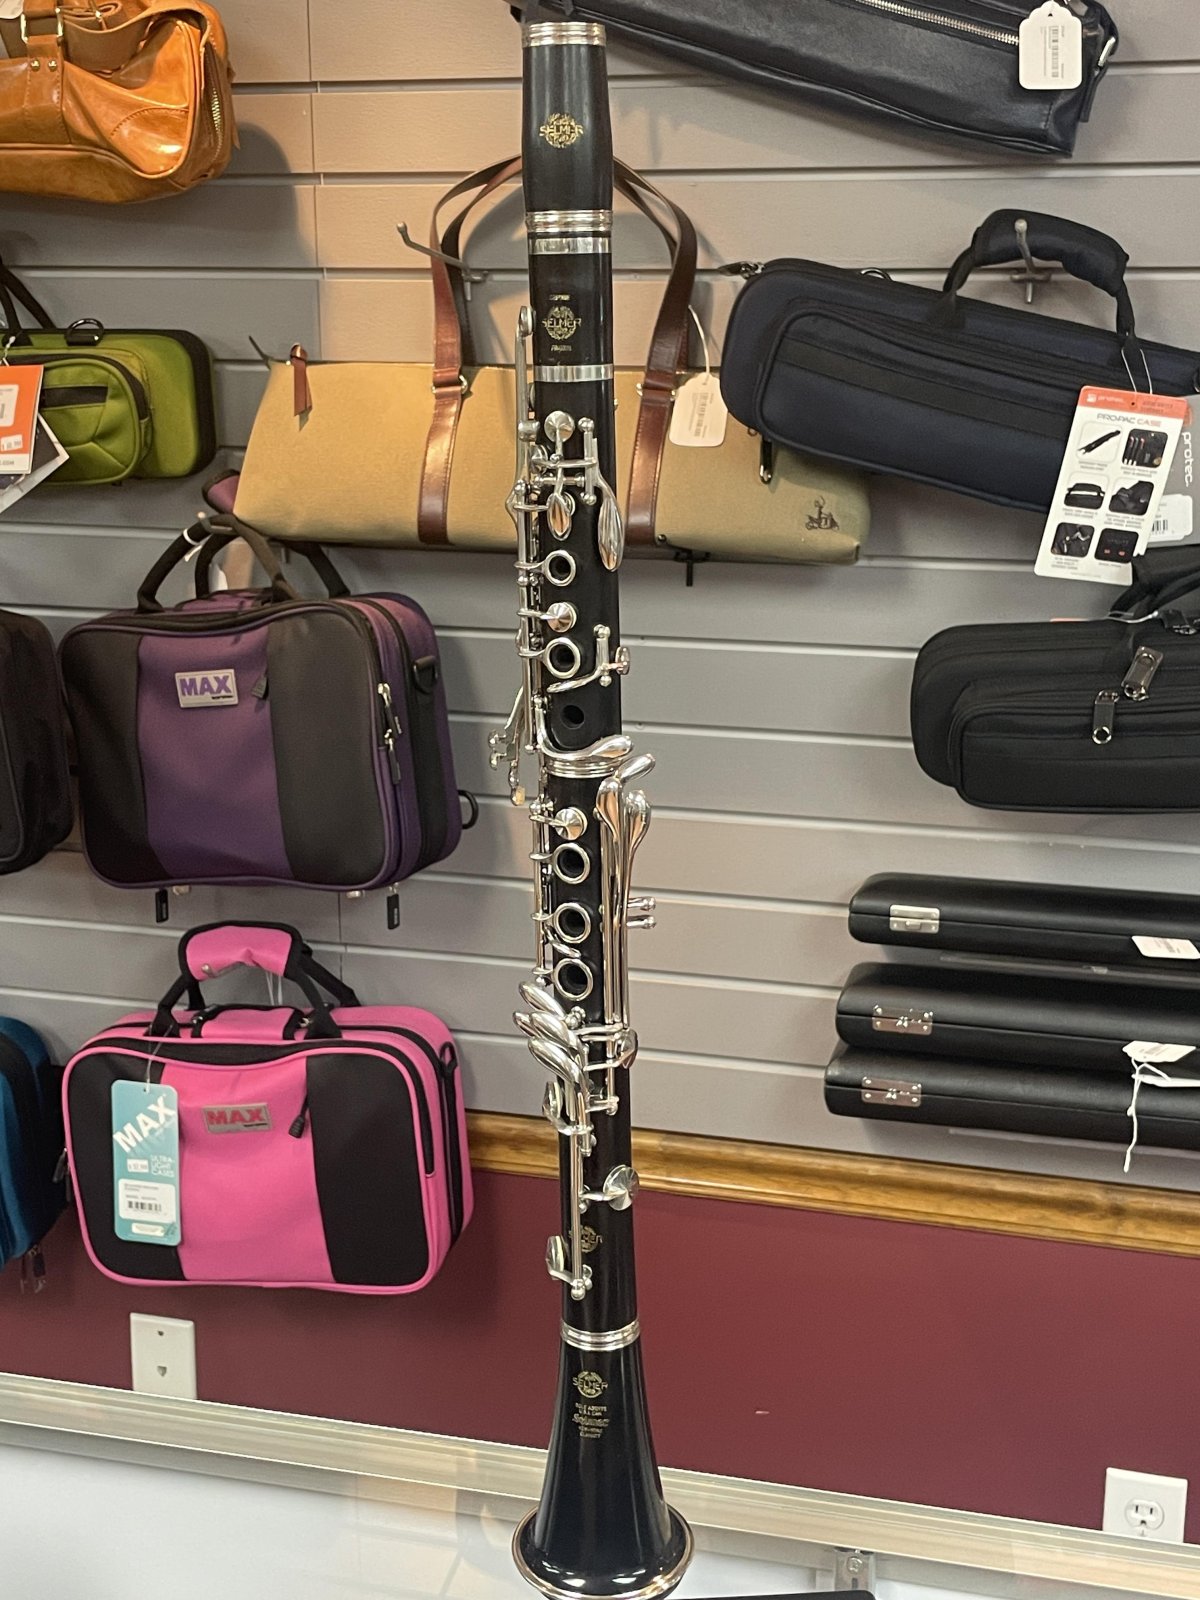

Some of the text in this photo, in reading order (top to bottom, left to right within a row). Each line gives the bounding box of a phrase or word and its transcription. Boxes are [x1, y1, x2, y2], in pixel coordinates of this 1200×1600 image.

[539, 124, 584, 136] SELMER
[541, 317, 582, 328] SELMER
[179, 675, 232, 697] MAX
[113, 1094, 176, 1153] MAX
[207, 1108, 266, 1126] MAX
[572, 1377, 608, 1390] SELMER
